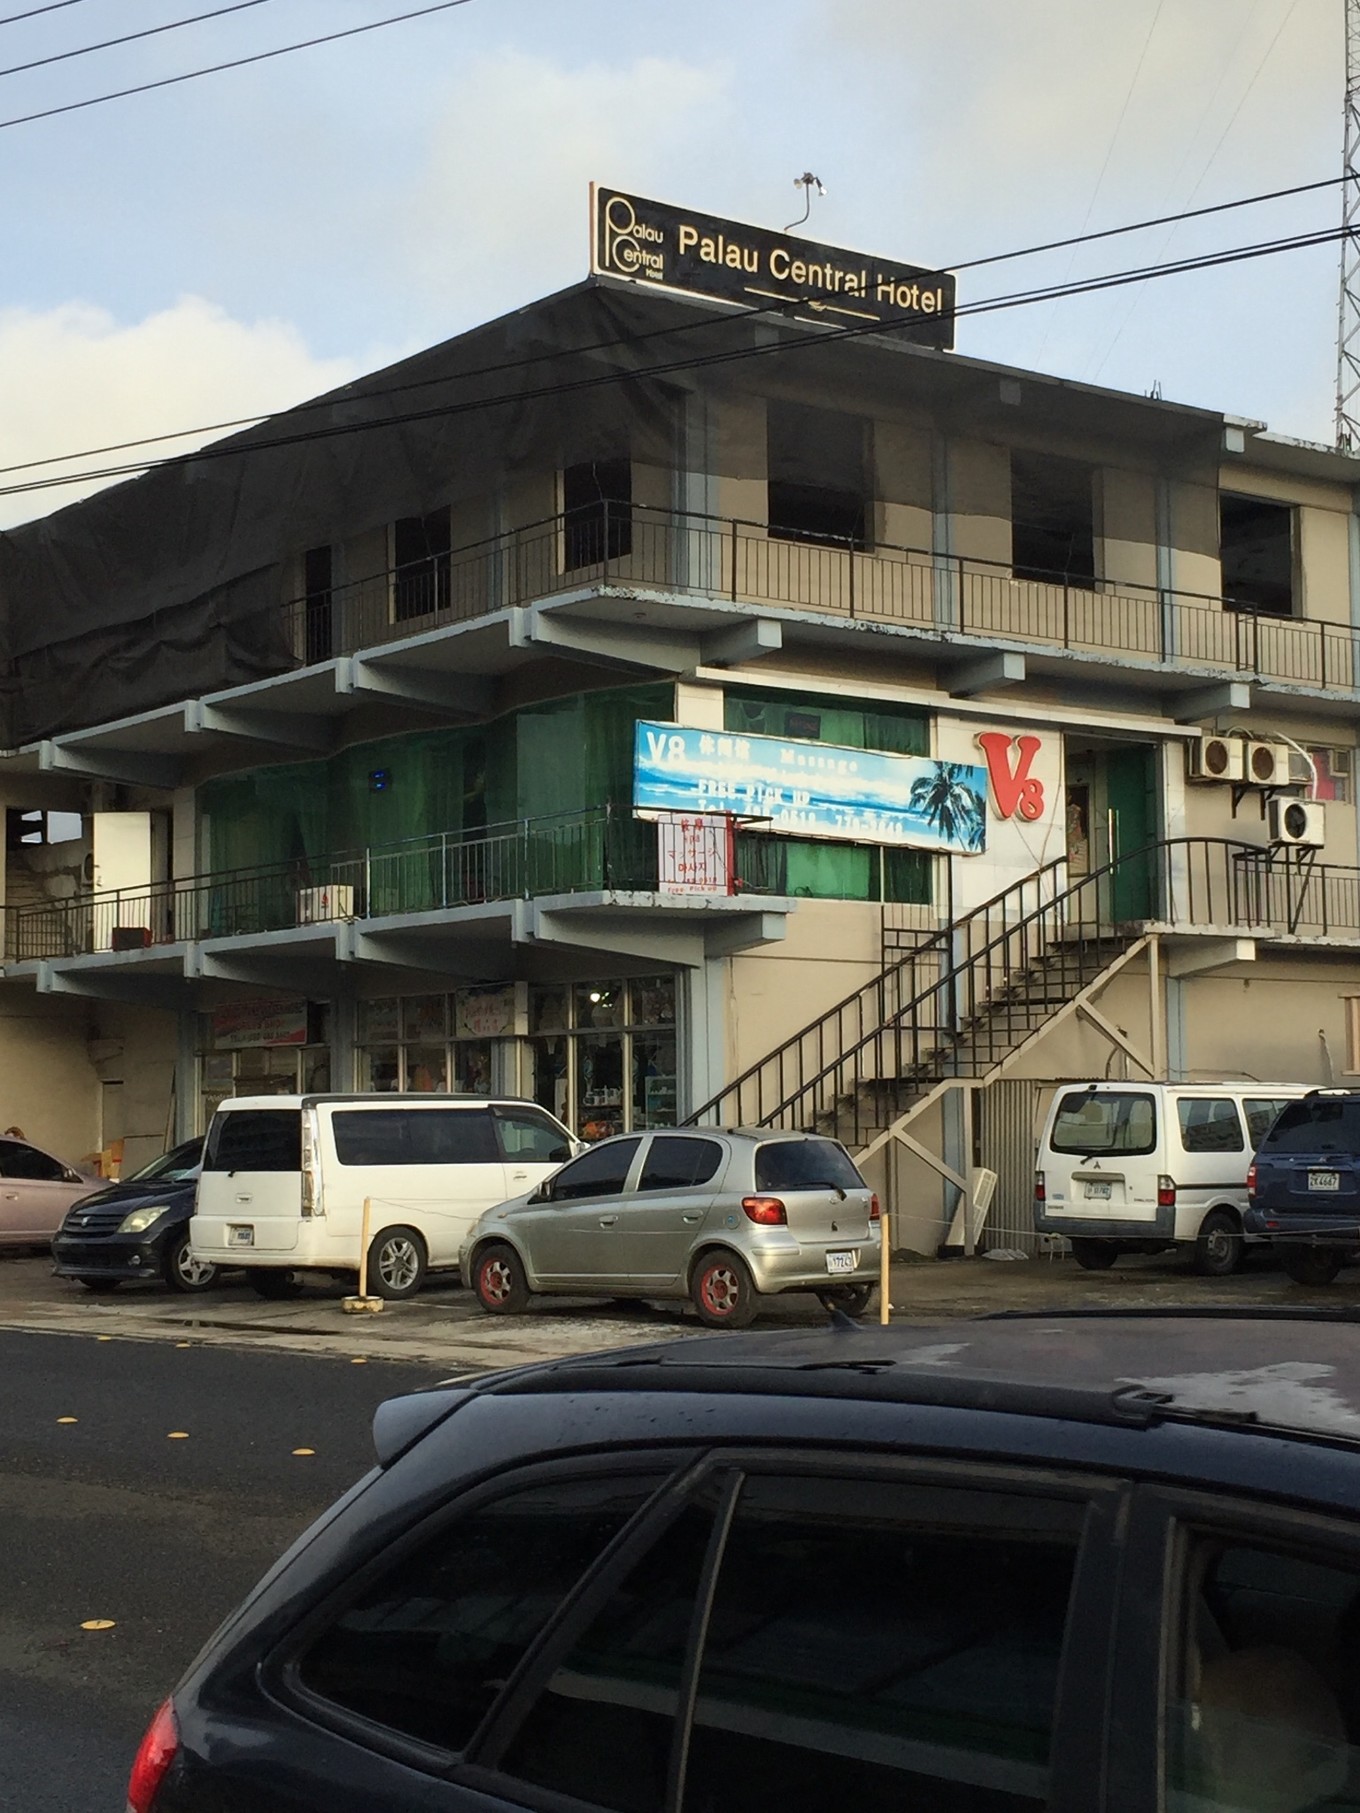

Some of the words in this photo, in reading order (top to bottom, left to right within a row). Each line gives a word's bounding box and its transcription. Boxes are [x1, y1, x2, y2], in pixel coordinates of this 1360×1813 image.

[605, 196, 664, 268] Palau
[612, 235, 664, 273] Central
[678, 225, 758, 273] Palau
[770, 248, 867, 298] Central
[877, 274, 943, 316] Hotel
[646, 731, 686, 763] V8
[780, 748, 858, 776] Massage
[698, 778, 735, 798] FREE
[793, 790, 811, 806] UP
[978, 732, 1044, 821] V8
